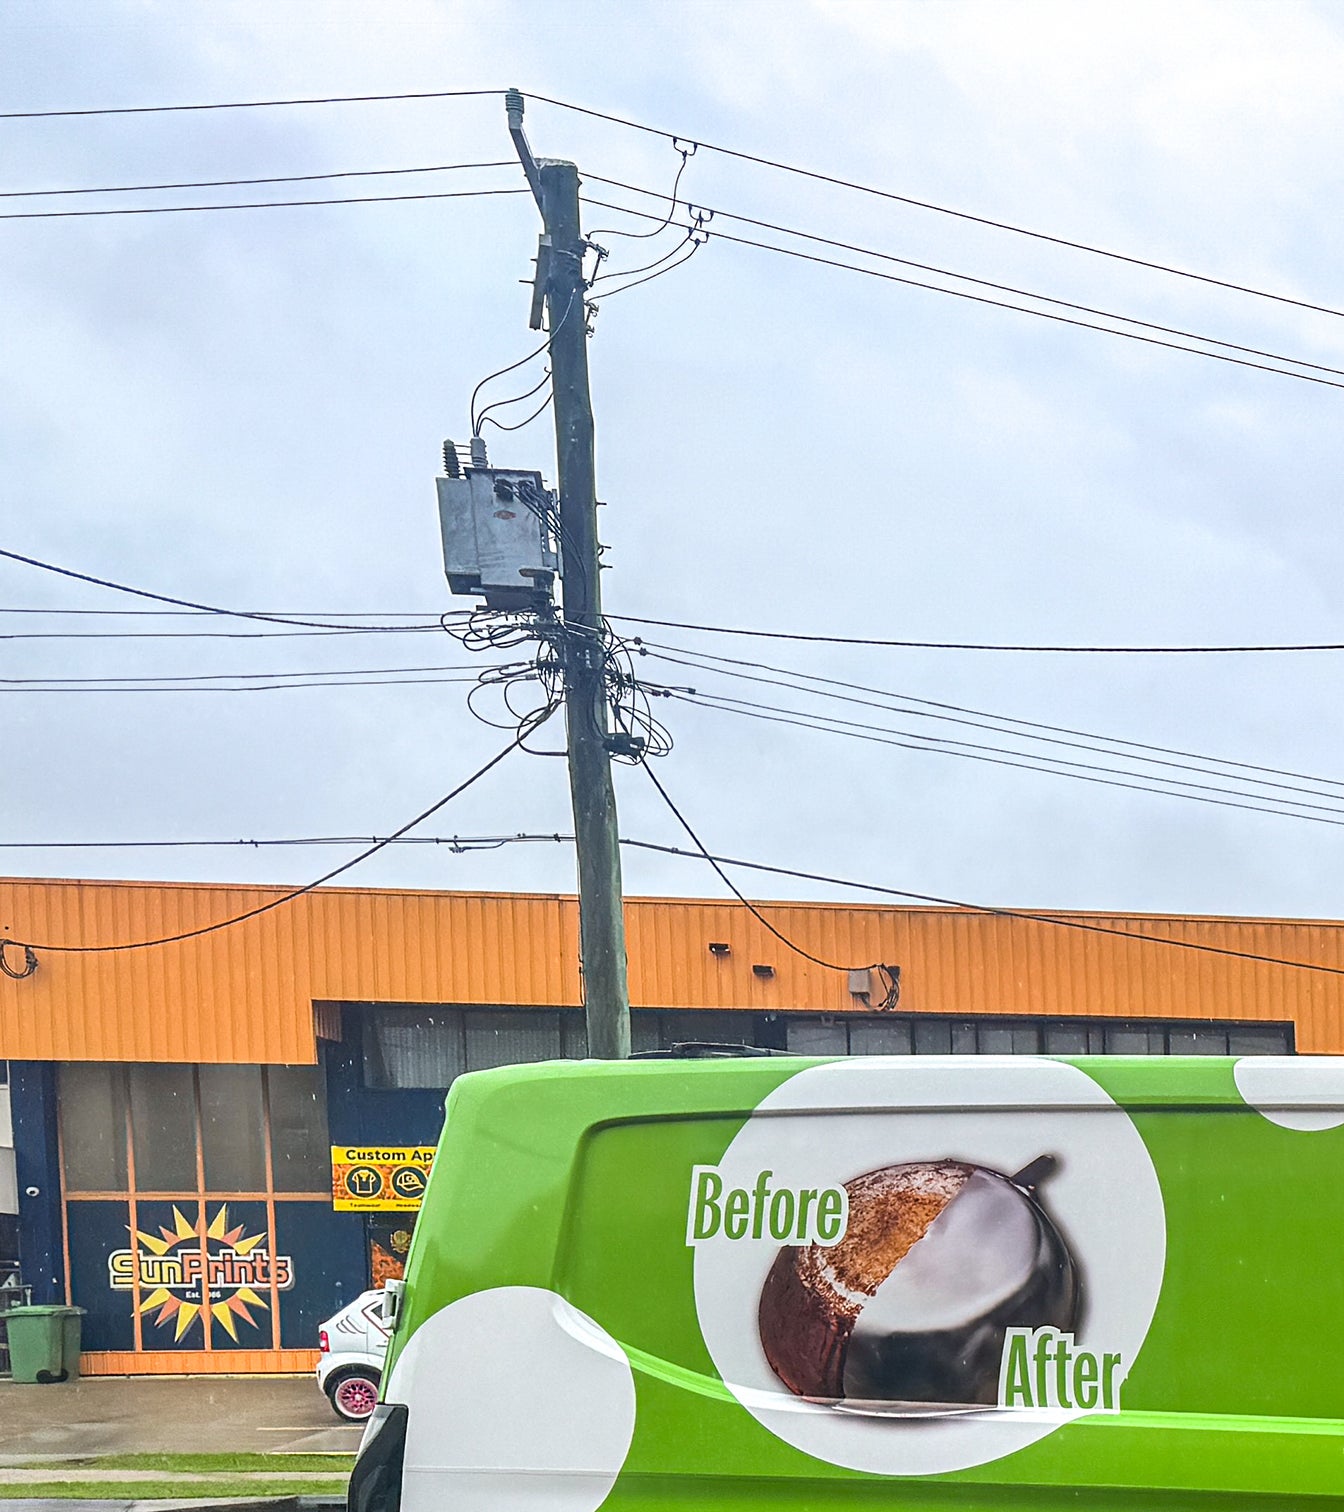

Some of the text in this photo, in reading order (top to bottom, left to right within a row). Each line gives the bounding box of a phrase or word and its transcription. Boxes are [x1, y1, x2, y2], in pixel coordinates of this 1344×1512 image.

[346, 1150, 437, 1163] Custom Ap
[693, 1170, 844, 1241] Before
[110, 1250, 292, 1286] SunPrints
[1004, 1333, 1123, 1409] After
